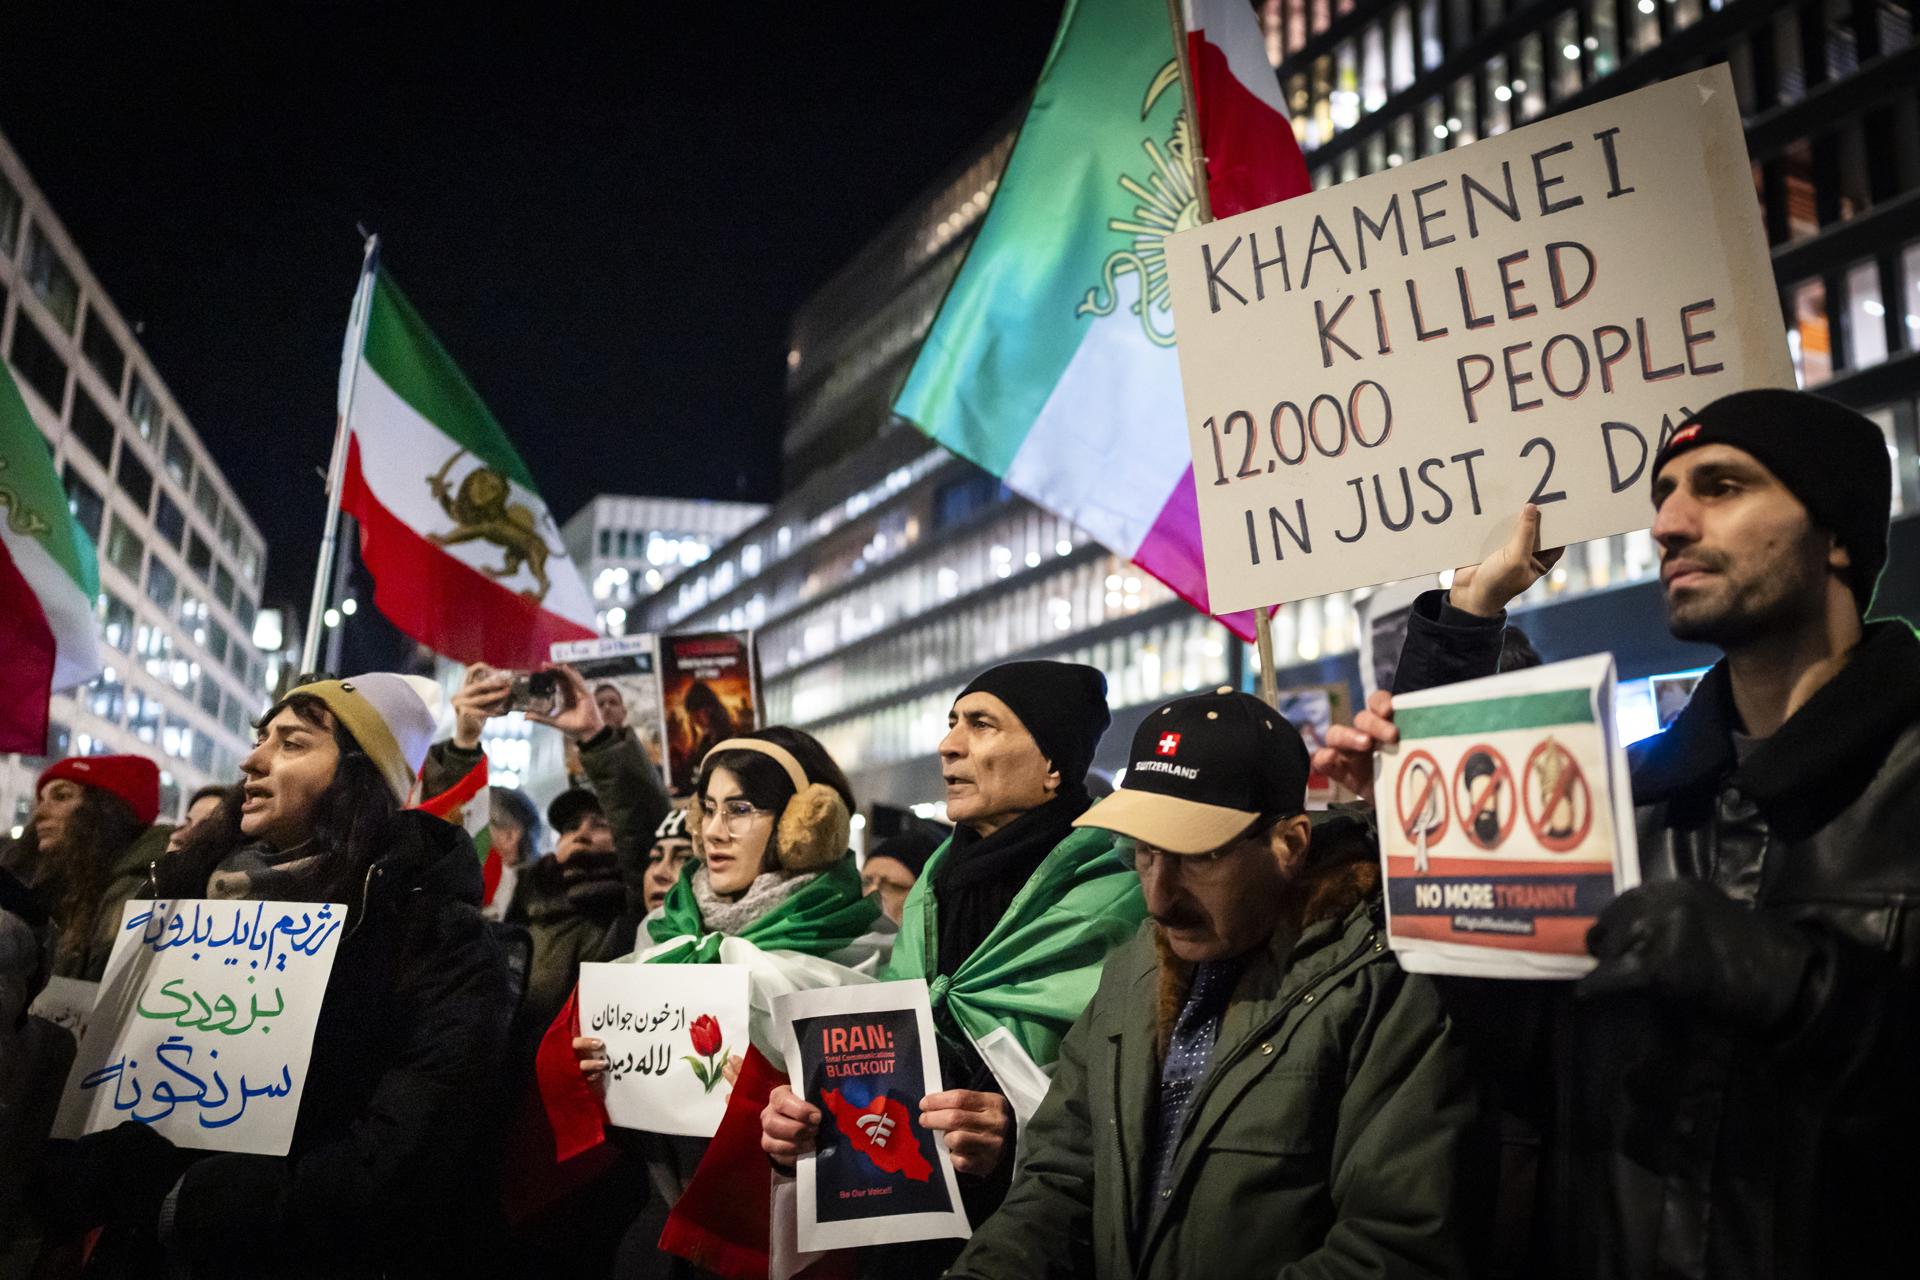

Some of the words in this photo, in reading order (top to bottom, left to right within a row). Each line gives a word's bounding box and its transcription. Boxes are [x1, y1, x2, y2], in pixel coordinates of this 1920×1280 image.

[1201, 127, 1634, 314] KHAMENEI
[1314, 240, 1597, 368] KILLED
[1202, 379, 1393, 486] 12,000
[1457, 298, 1724, 424] PEOPLE
[1245, 498, 1312, 565] IN
[1334, 448, 1485, 543] JUST
[1519, 436, 1567, 506] 2
[1135, 760, 1198, 780] SWITZERLAND
[1415, 883, 1443, 909] NO
[1444, 883, 1495, 910] MORE
[1496, 884, 1577, 910] TYRANNY
[591, 1003, 634, 1032] جوانان
[634, 1002, 671, 1033] خون
[670, 1005, 686, 1032] از
[822, 1024, 894, 1054] IRAN:
[826, 1060, 895, 1078] BLACKOUT
